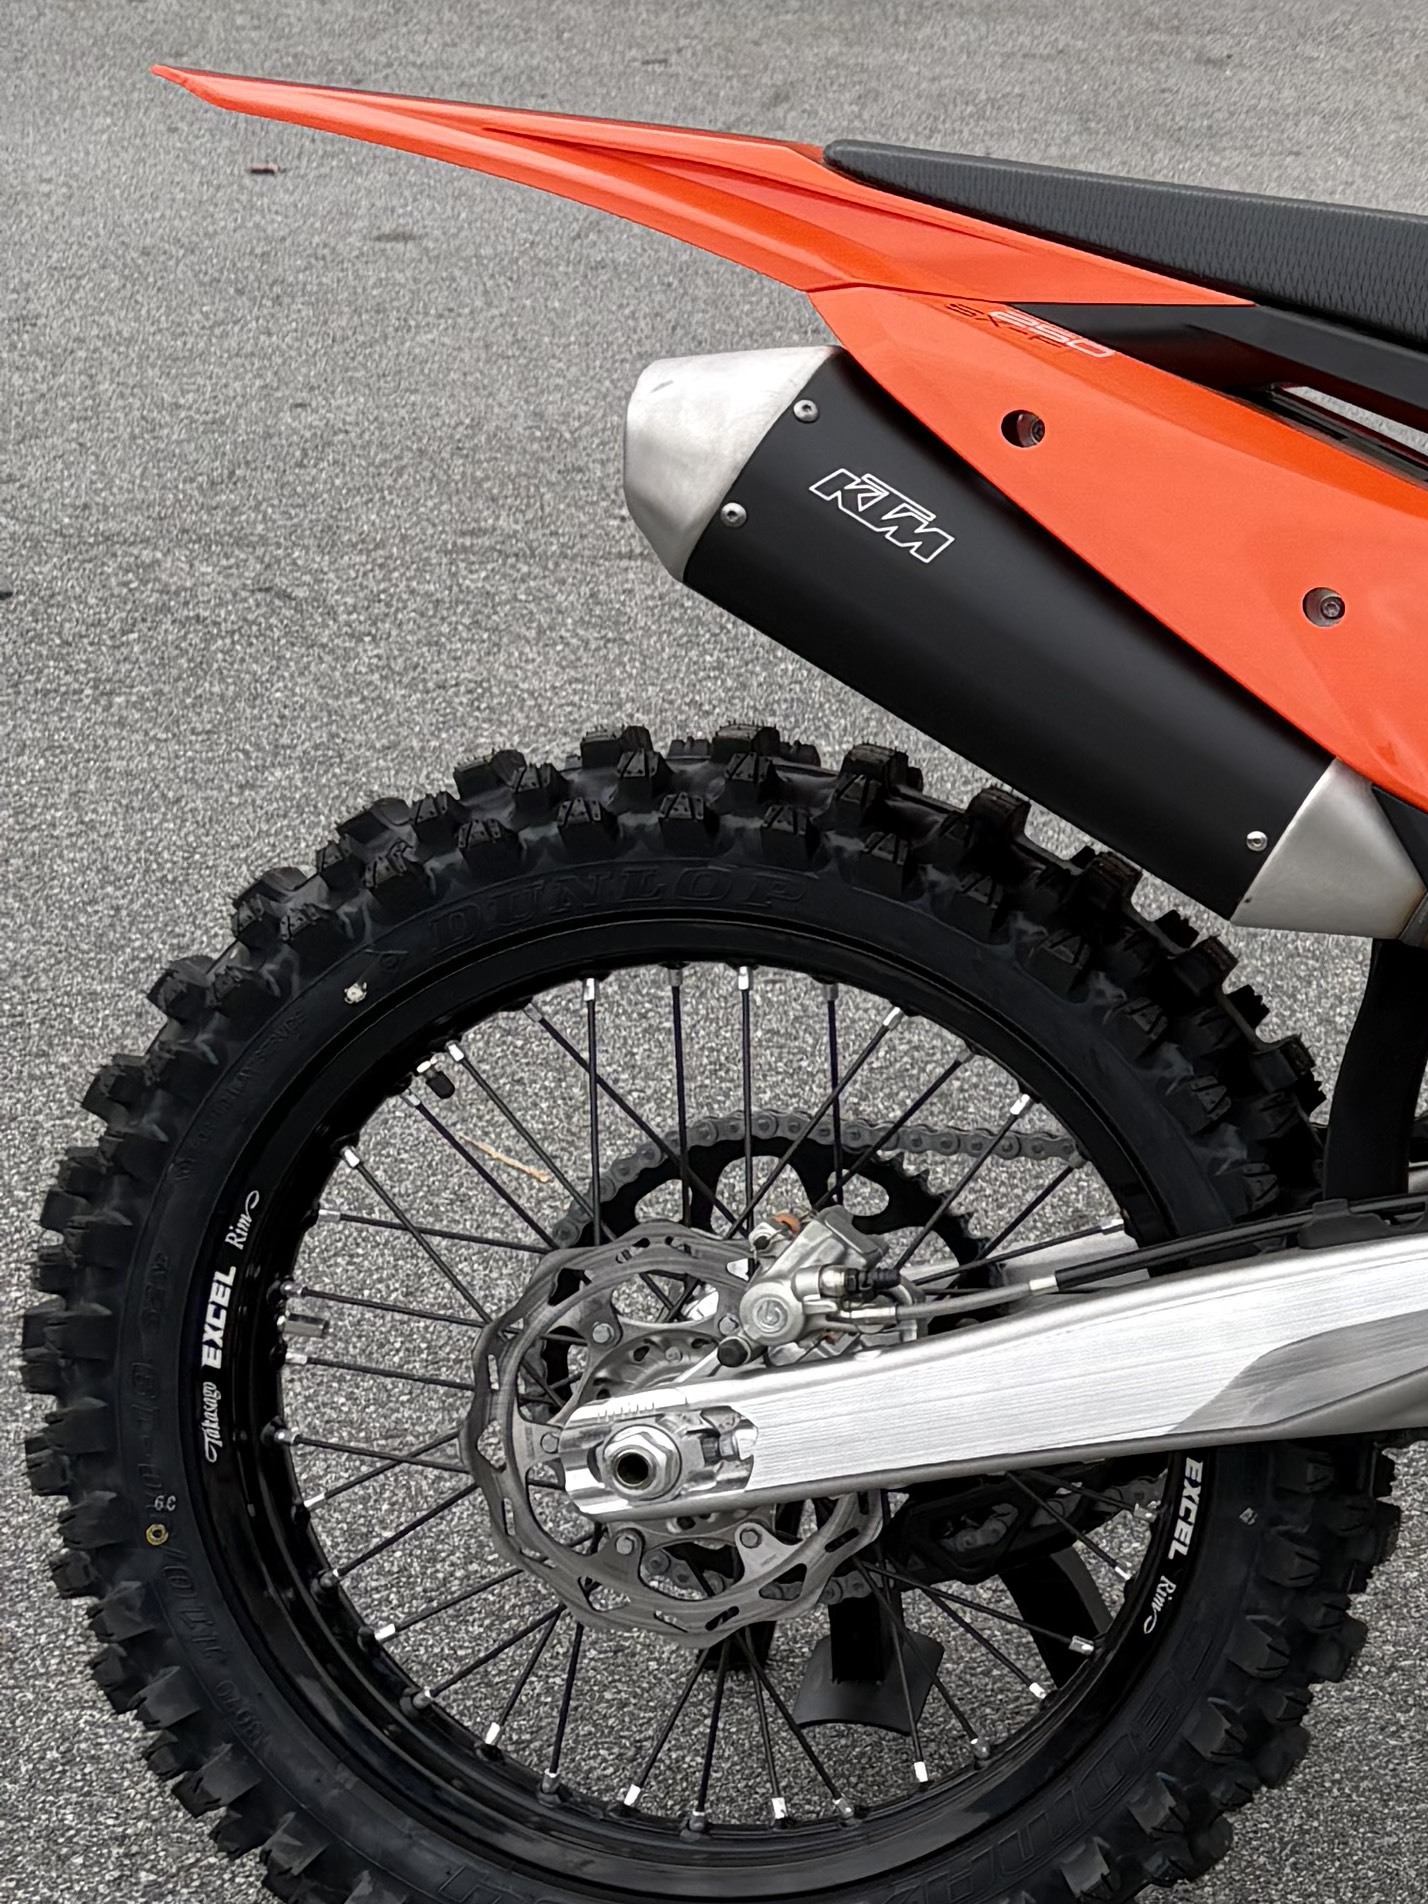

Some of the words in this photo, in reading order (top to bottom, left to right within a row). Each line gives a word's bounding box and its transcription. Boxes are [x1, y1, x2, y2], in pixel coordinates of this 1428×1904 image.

[988, 310, 1116, 358] 250
[808, 467, 955, 564] KTM
[427, 865, 810, 954] DUNLOP
[224, 1190, 260, 1251] Rim
[201, 1265, 237, 1370] EXCEL
[201, 1381, 223, 1463] Takasago
[1167, 1456, 1204, 1560] EXCEL
[1143, 1574, 1177, 1635] Rim
